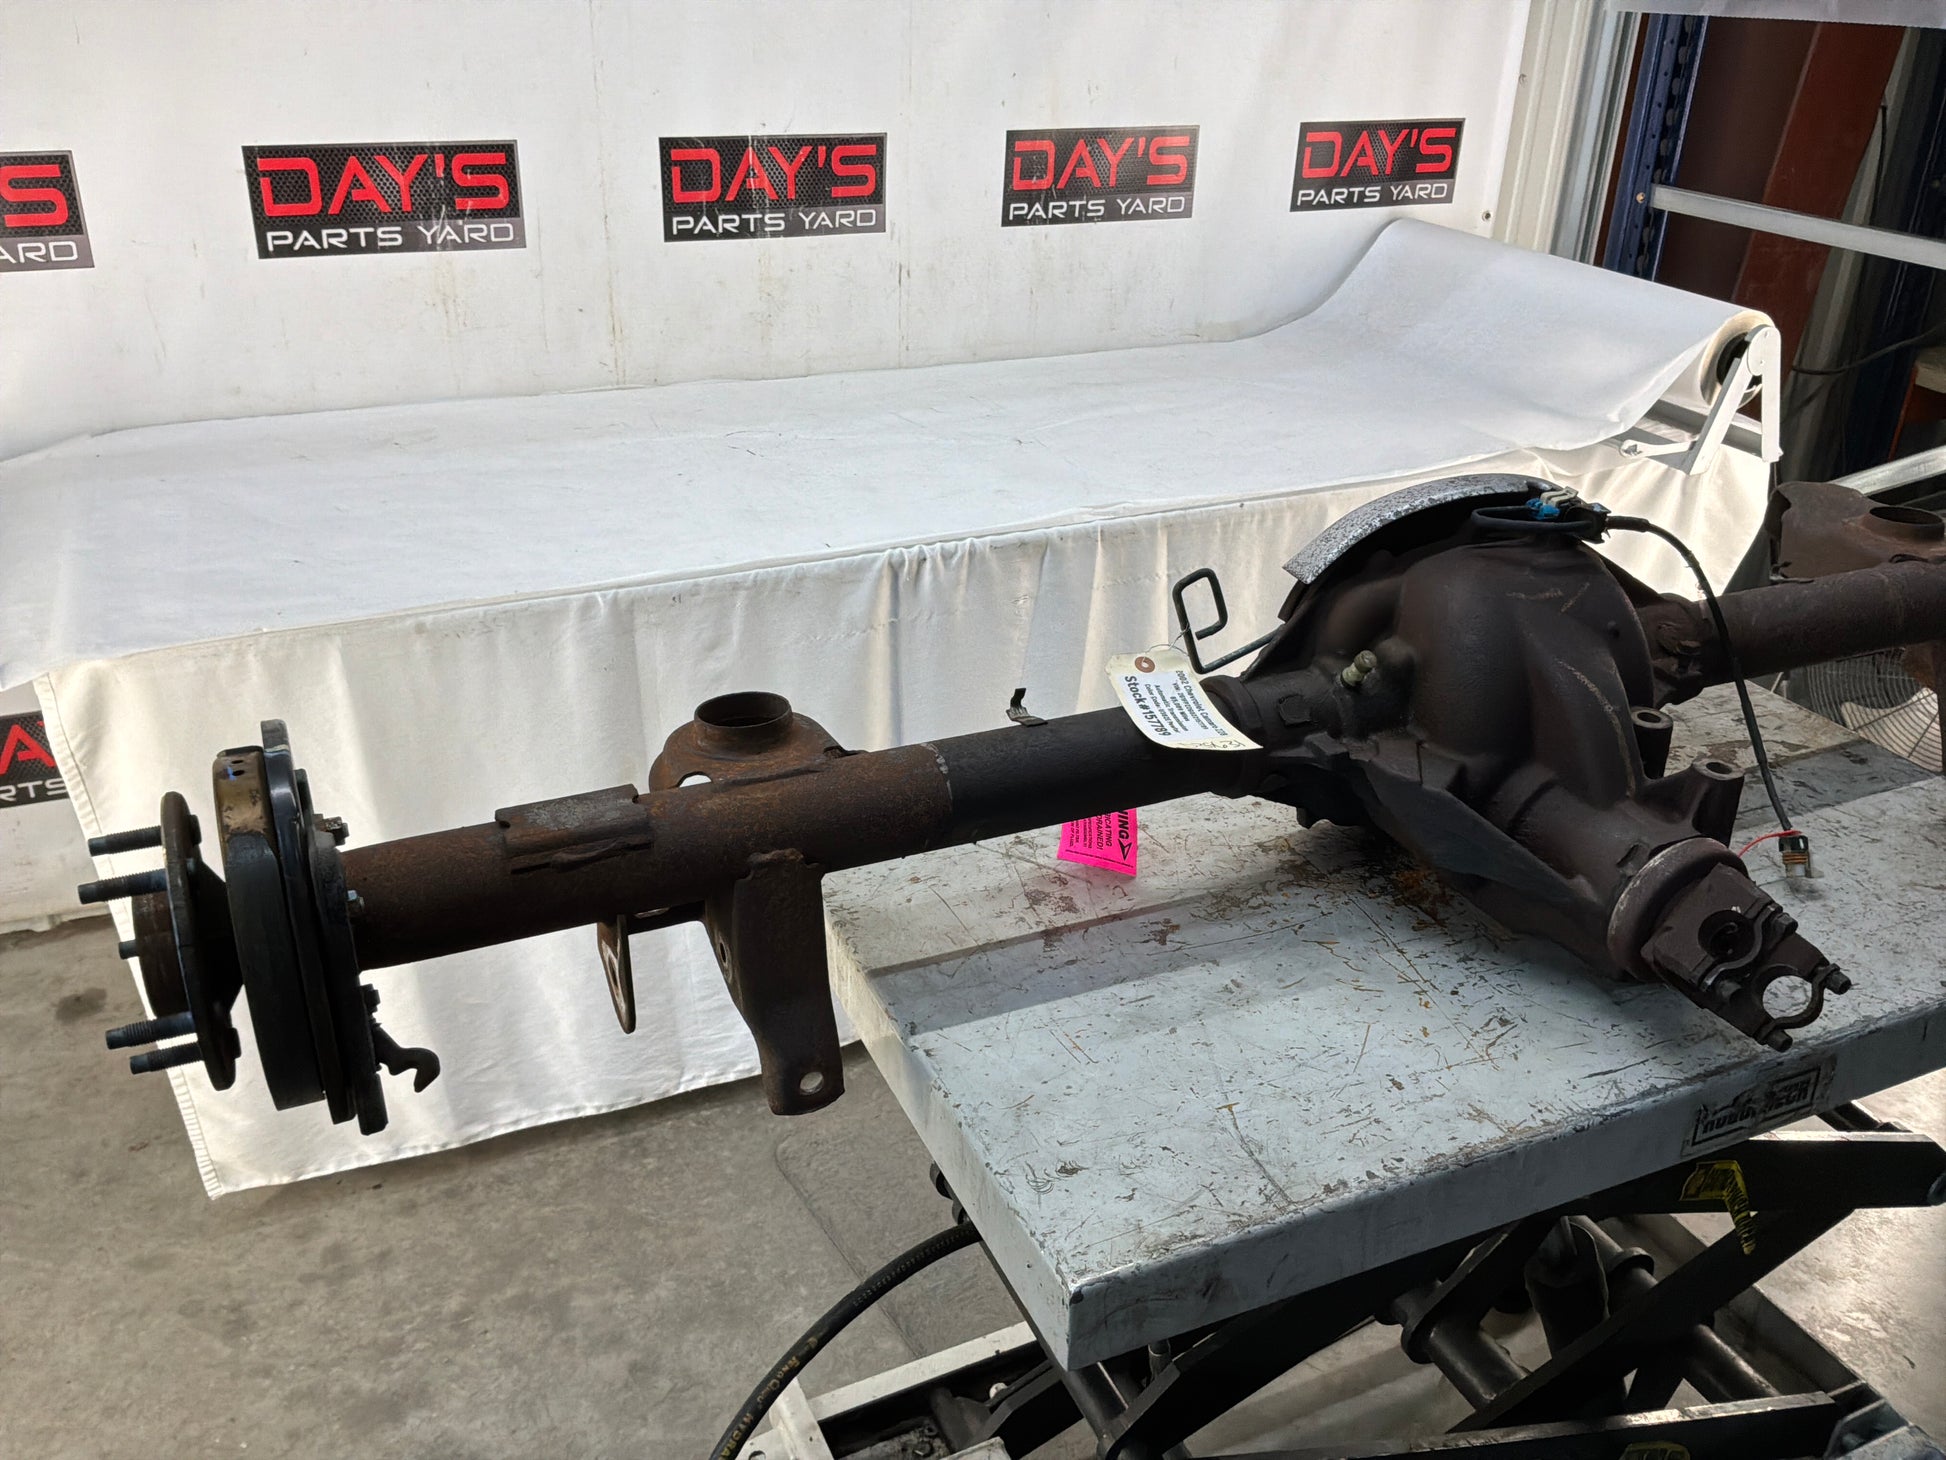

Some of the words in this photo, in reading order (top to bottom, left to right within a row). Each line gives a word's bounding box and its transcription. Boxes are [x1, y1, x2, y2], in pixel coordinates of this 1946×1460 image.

[671, 144, 877, 202] DAY'S
[1013, 136, 1190, 191] DAY'S
[1302, 128, 1457, 178] DAY'S
[257, 152, 509, 217] DAY'S
[1008, 199, 1105, 220] PARTS
[1116, 196, 1186, 214] YARD
[1297, 186, 1381, 206] PARTS
[1390, 183, 1448, 200] YARD
[266, 229, 403, 252] PARTS
[417, 223, 514, 245] YARD
[671, 213, 786, 235] PARTS
[797, 209, 876, 229] YARD
[1124, 675, 1171, 737] Stock#157789
[1144, 683, 1154, 695] Color
[1153, 684, 1170, 707] Automatic
[1167, 707, 1188, 731] Transmission
[1176, 670, 1188, 685] 2002
[1183, 685, 1205, 711] Chevrolet
[1200, 711, 1218, 728] Camaro
